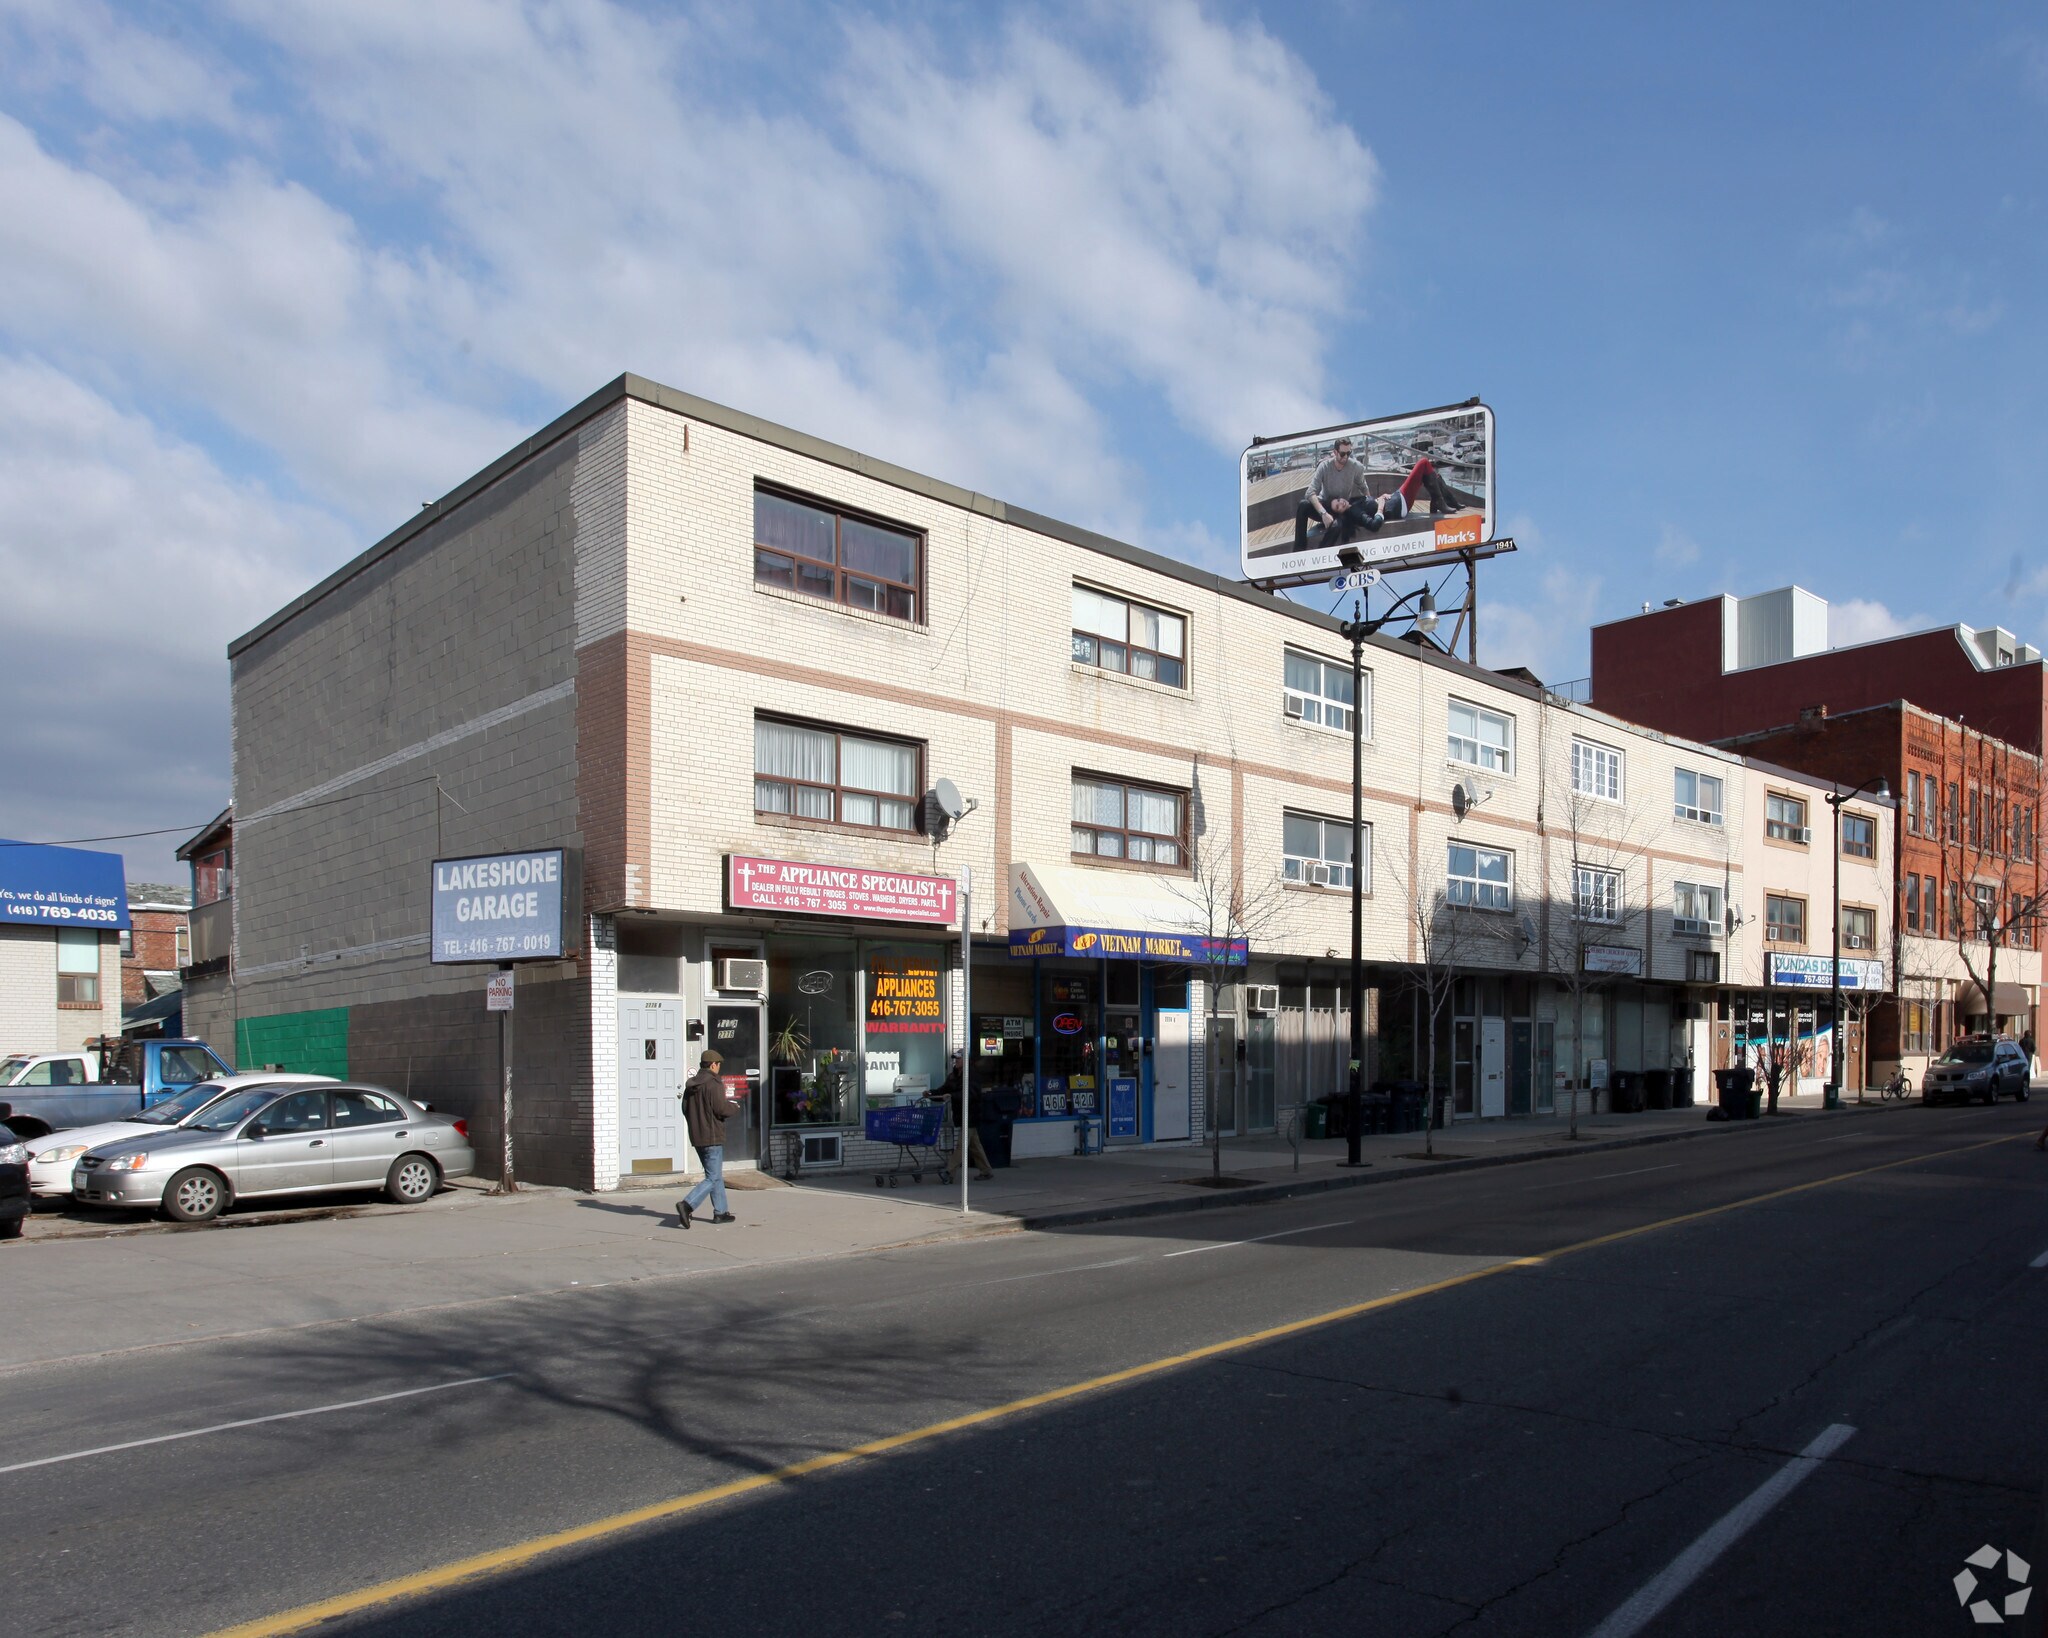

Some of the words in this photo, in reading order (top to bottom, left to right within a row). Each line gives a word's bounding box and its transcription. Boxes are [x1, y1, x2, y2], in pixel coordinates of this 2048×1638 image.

[1437, 531, 1475, 545] Mark's
[1496, 541, 1513, 550] 1941
[1282, 558, 1306, 569] NOW
[1312, 548, 1377, 565] WELCNG
[1382, 540, 1425, 554] WOMEN
[1348, 571, 1375, 587] CBS
[438, 856, 558, 892] LAKESHORE
[757, 864, 776, 875] THE
[779, 866, 858, 889] APPLIANCE
[862, 874, 936, 897] SPECIALIST
[18, 892, 32, 900] we
[34, 891, 45, 901] do
[47, 892, 58, 902] all
[60, 893, 83, 904] kinds
[85, 895, 93, 904] of
[752, 882, 774, 893] DEALER
[775, 885, 781, 893] IN
[781, 885, 799, 895] FULLY
[800, 887, 821, 897] REBUILT
[823, 889, 845, 899] FRIDGES
[849, 891, 869, 901] STOVES
[872, 894, 896, 904] WASHERS
[899, 896, 918, 906] DRYERS
[1014, 886, 1027, 909] Phone
[1019, 871, 1038, 901] Alteration
[1037, 897, 1050, 919] Repair
[7, 904, 38, 916] (416)
[39, 906, 118, 922] 769-4036
[456, 891, 538, 922] GARAGE
[1010, 945, 1034, 957] VIETNAM
[1035, 943, 1057, 955] MARKET
[1100, 935, 1141, 954] VIETNAM
[1145, 938, 1182, 956] MARKET
[1775, 956, 1819, 973] DUNDAS
[1821, 962, 1858, 975] DETAL
[495, 978, 506, 987] NO
[877, 978, 935, 998] APPLIANCES
[1804, 975, 1833, 984] 767-9591
[488, 986, 513, 997] PARKING
[871, 999, 940, 1016] 416-767-3055
[865, 1022, 946, 1033] WARRANTY
[1057, 1017, 1083, 1030] OPEN
